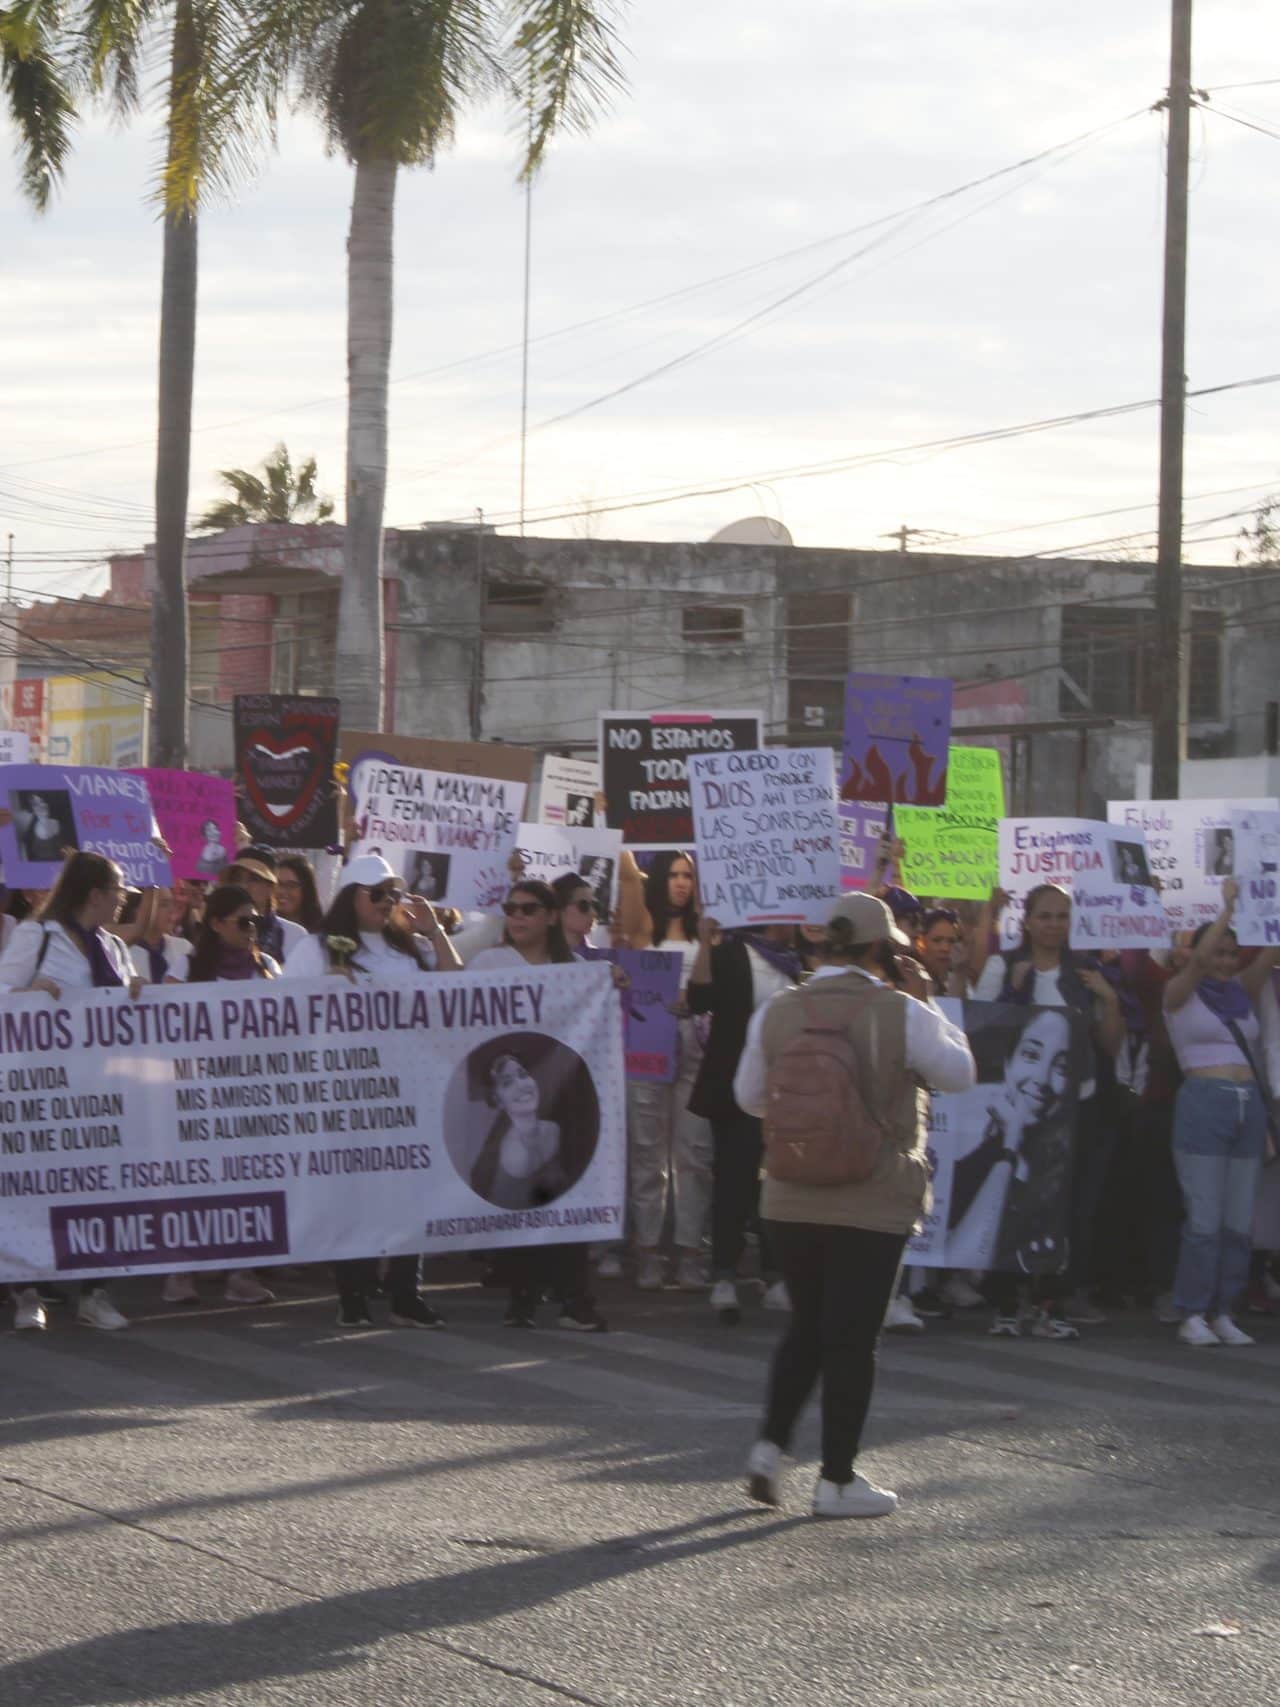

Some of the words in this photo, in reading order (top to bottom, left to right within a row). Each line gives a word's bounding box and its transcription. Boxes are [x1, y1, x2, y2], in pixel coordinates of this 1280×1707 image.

[608, 728, 642, 750] NO
[650, 728, 735, 750] ESTAMOS
[694, 757, 722, 777] ME
[727, 754, 780, 773] QUEDO
[788, 752, 816, 769] CON
[434, 777, 506, 809] MAXIMA
[701, 780, 755, 810] DIOS
[494, 811, 516, 835] DE
[700, 814, 737, 840] LAS
[742, 808, 834, 836] SONRISAS
[792, 836, 835, 853] AMOR
[1015, 826, 1094, 851] Exigimos
[520, 848, 577, 867] STICIA!
[805, 857, 817, 874] Y
[1010, 850, 1105, 874] JUSTICIA
[702, 883, 728, 906] LA
[730, 879, 780, 915] PAZ
[1078, 916, 1097, 937] AL
[83, 1001, 214, 1048] JUSTICIA
[223, 995, 299, 1040] PARA
[308, 989, 429, 1035] FABIOLA
[437, 984, 546, 1029] VIANEY
[8, 1066, 70, 1091] OLVIDA
[173, 1058, 193, 1081] MI
[197, 1053, 264, 1080] FAMILIA
[267, 1052, 289, 1075] NO
[293, 1050, 319, 1073] ME
[323, 1046, 381, 1072] OLVIDA
[21, 1098, 47, 1122] ME
[51, 1094, 125, 1120] OLVIDAN
[176, 1088, 207, 1113] MIS
[211, 1084, 272, 1110] AMIGOS
[274, 1082, 298, 1105] NO
[302, 1080, 329, 1103] ME
[333, 1076, 401, 1102] OLVIDAN
[178, 1117, 209, 1143] MIS
[213, 1113, 291, 1141] ALUMNOS
[295, 1111, 318, 1135] NO
[322, 1109, 346, 1133] ME
[349, 1105, 418, 1131] OLVIDAN
[1, 1130, 26, 1155] NO
[30, 1129, 57, 1153] ME
[60, 1124, 123, 1152] OLVIDA
[120, 1158, 216, 1190] FISCALES,
[220, 1152, 286, 1183] JUECES
[290, 1150, 302, 1178] Y
[307, 1143, 432, 1176] AUTORIDADES
[67, 1217, 108, 1255] NO
[113, 1213, 156, 1252] ME
[161, 1205, 274, 1249] OLVIDEN
[423, 1204, 621, 1239] #JUSTICIAPARAFABIOLAVIANEY
